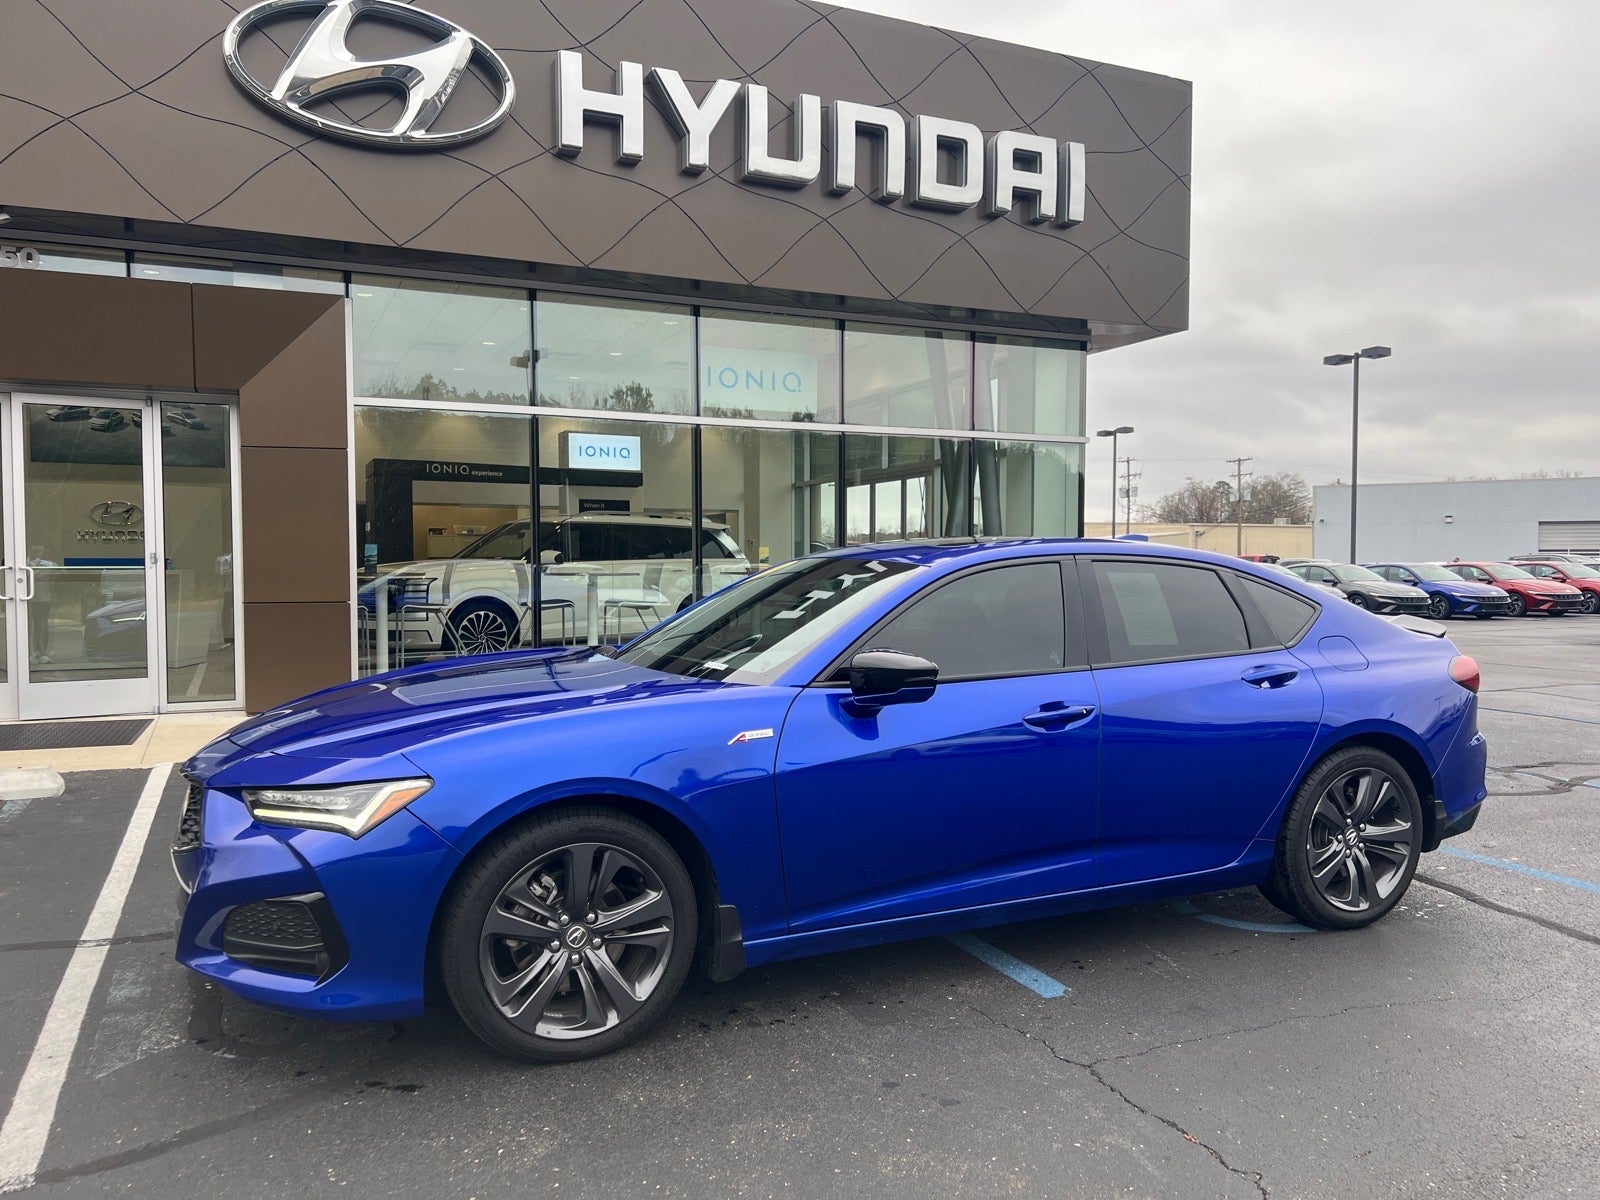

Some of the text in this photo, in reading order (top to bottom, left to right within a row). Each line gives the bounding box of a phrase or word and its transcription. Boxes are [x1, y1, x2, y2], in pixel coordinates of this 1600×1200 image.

[555, 49, 1087, 227] HYUNDAI
[707, 366, 802, 393] IONIQ
[579, 445, 631, 458] IONIQ
[426, 463, 503, 477] IONIQ experience
